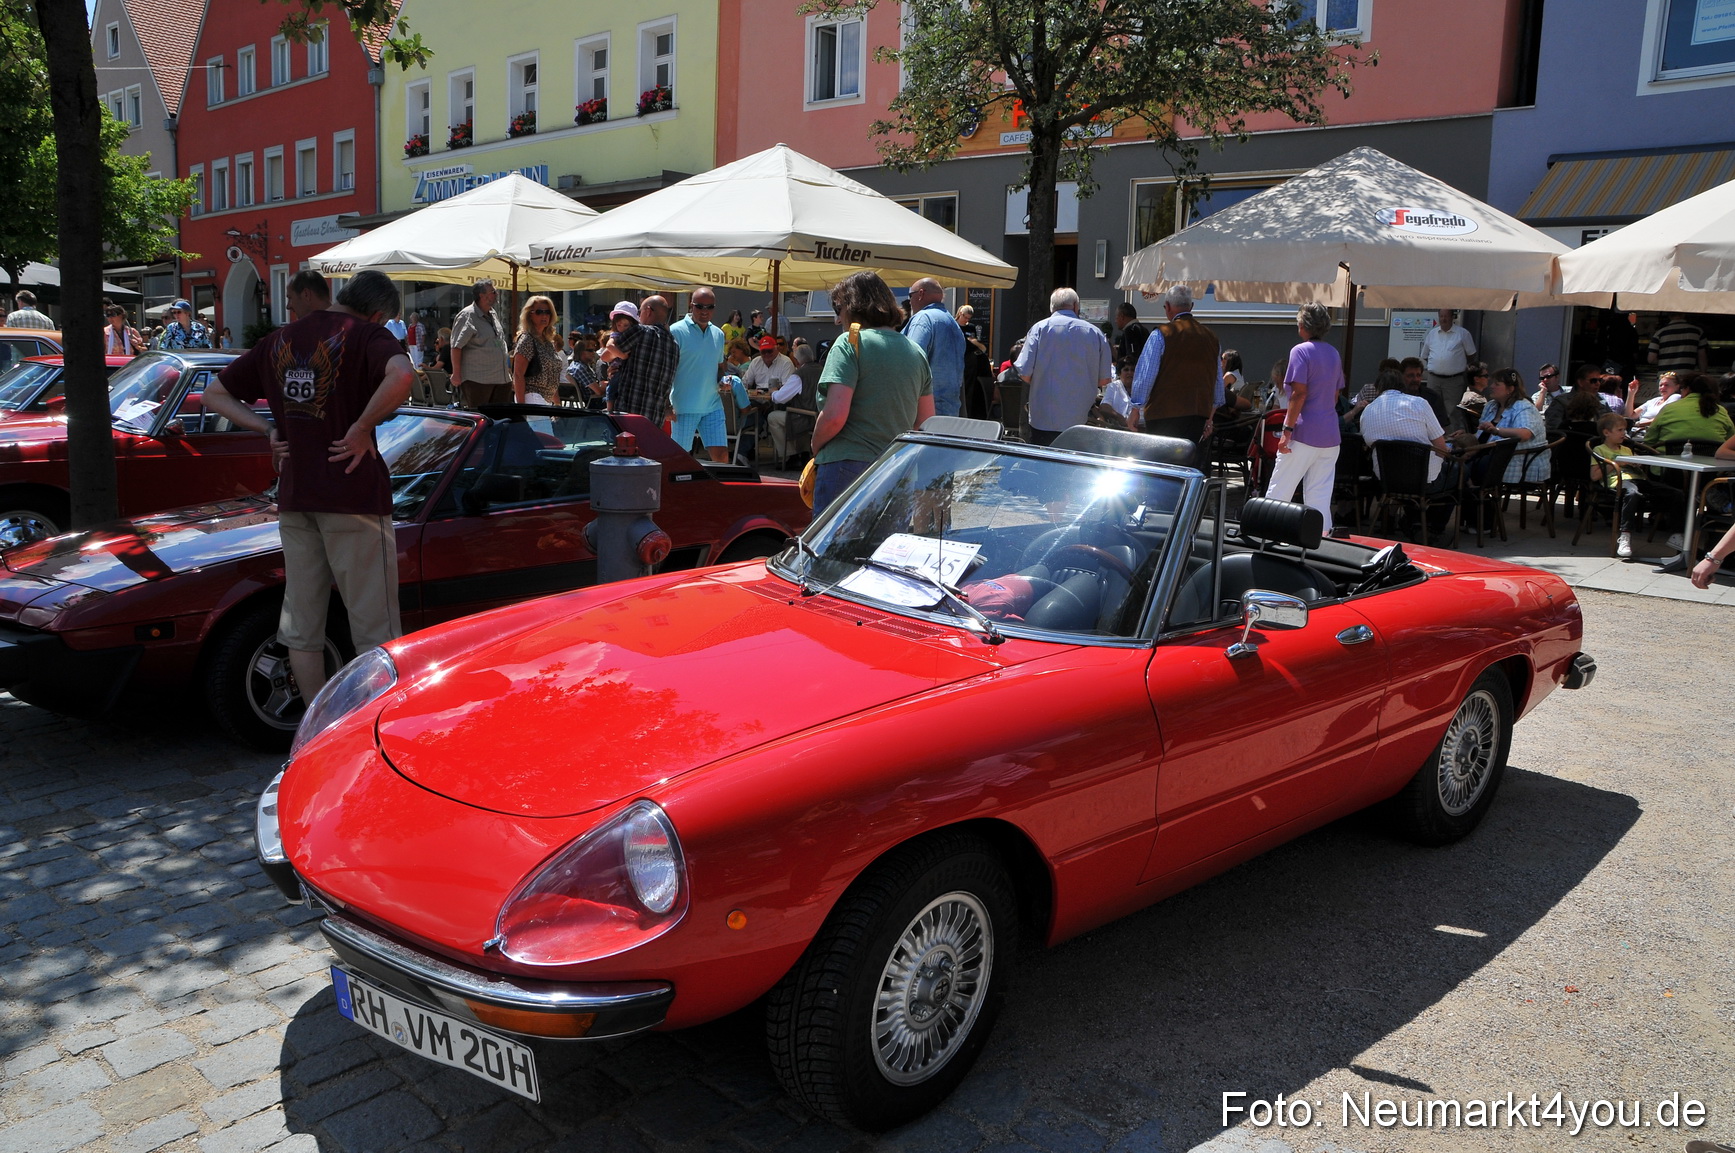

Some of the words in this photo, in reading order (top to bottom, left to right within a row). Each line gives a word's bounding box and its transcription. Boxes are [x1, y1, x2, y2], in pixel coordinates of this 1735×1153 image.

[426, 166, 465, 179] EISENWAREN
[411, 166, 547, 204] ZIMMERN
[1389, 209, 1466, 227] Segafredo
[294, 224, 320, 243] Gasthaus
[543, 245, 592, 262] Tucher
[815, 241, 872, 263] Tucher
[321, 261, 357, 274] Tucher
[288, 371, 313, 379] ROUTE
[287, 381, 312, 399] 66
[922, 552, 961, 577] 145
[349, 980, 390, 1035] RH
[403, 1007, 454, 1061] VM
[460, 1028, 533, 1095] 20H
